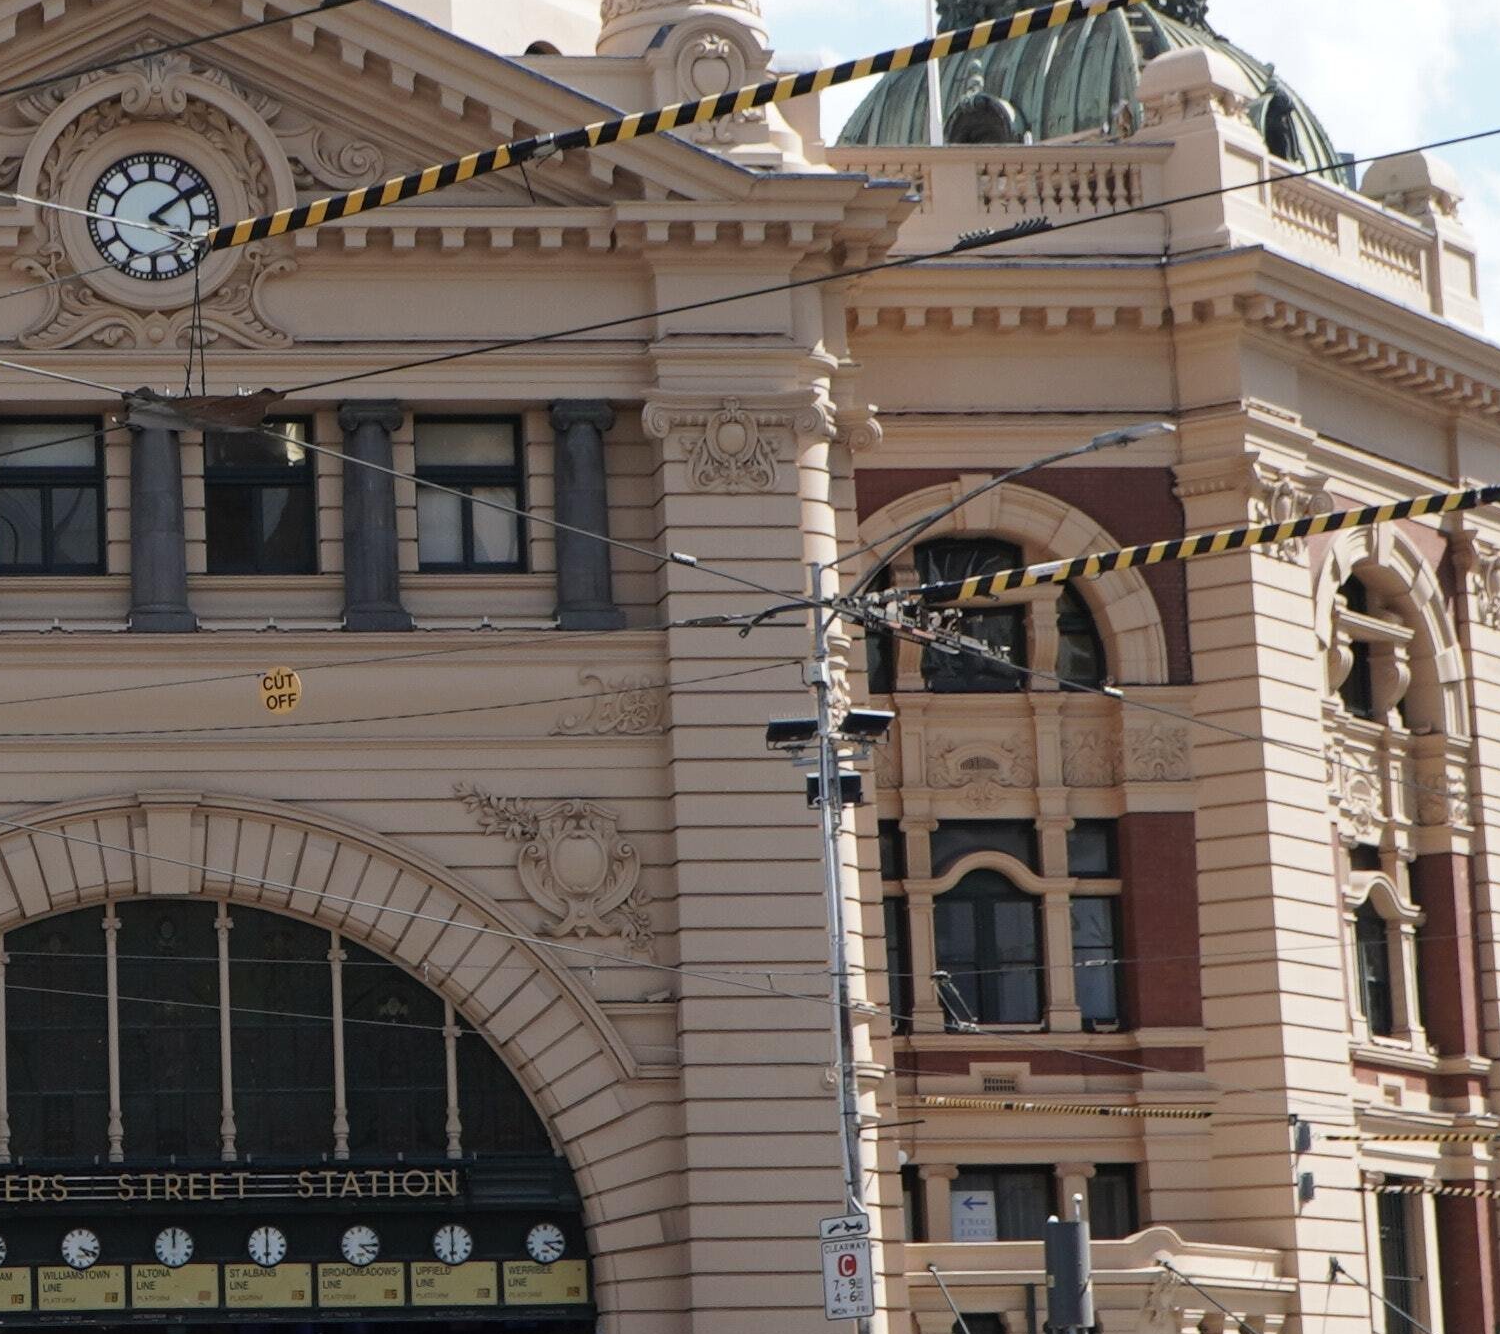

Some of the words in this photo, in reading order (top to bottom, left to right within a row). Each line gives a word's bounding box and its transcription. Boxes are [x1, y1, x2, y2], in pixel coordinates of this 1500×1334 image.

[263, 673, 294, 691] CUT
[266, 693, 297, 710] OFF
[117, 1172, 251, 1201] STREET
[297, 1168, 459, 1199] STATION
[824, 1242, 867, 1254] CLEARWAY
[43, 1270, 111, 1280] WILLIAMSTOWN
[136, 1268, 171, 1278] ALTONA
[229, 1268, 243, 1278] ST
[243, 1268, 277, 1278] ALBANS
[322, 1267, 398, 1277] BROADMEADOWS
[416, 1266, 451, 1276] UPFIELD
[136, 1281, 155, 1290] LINE
[229, 1281, 249, 1290] LINE
[323, 1280, 342, 1290] LINE
[416, 1278, 435, 1288] LINE
[508, 1278, 528, 1287] LINE
[43, 1283, 62, 1293] LINE
